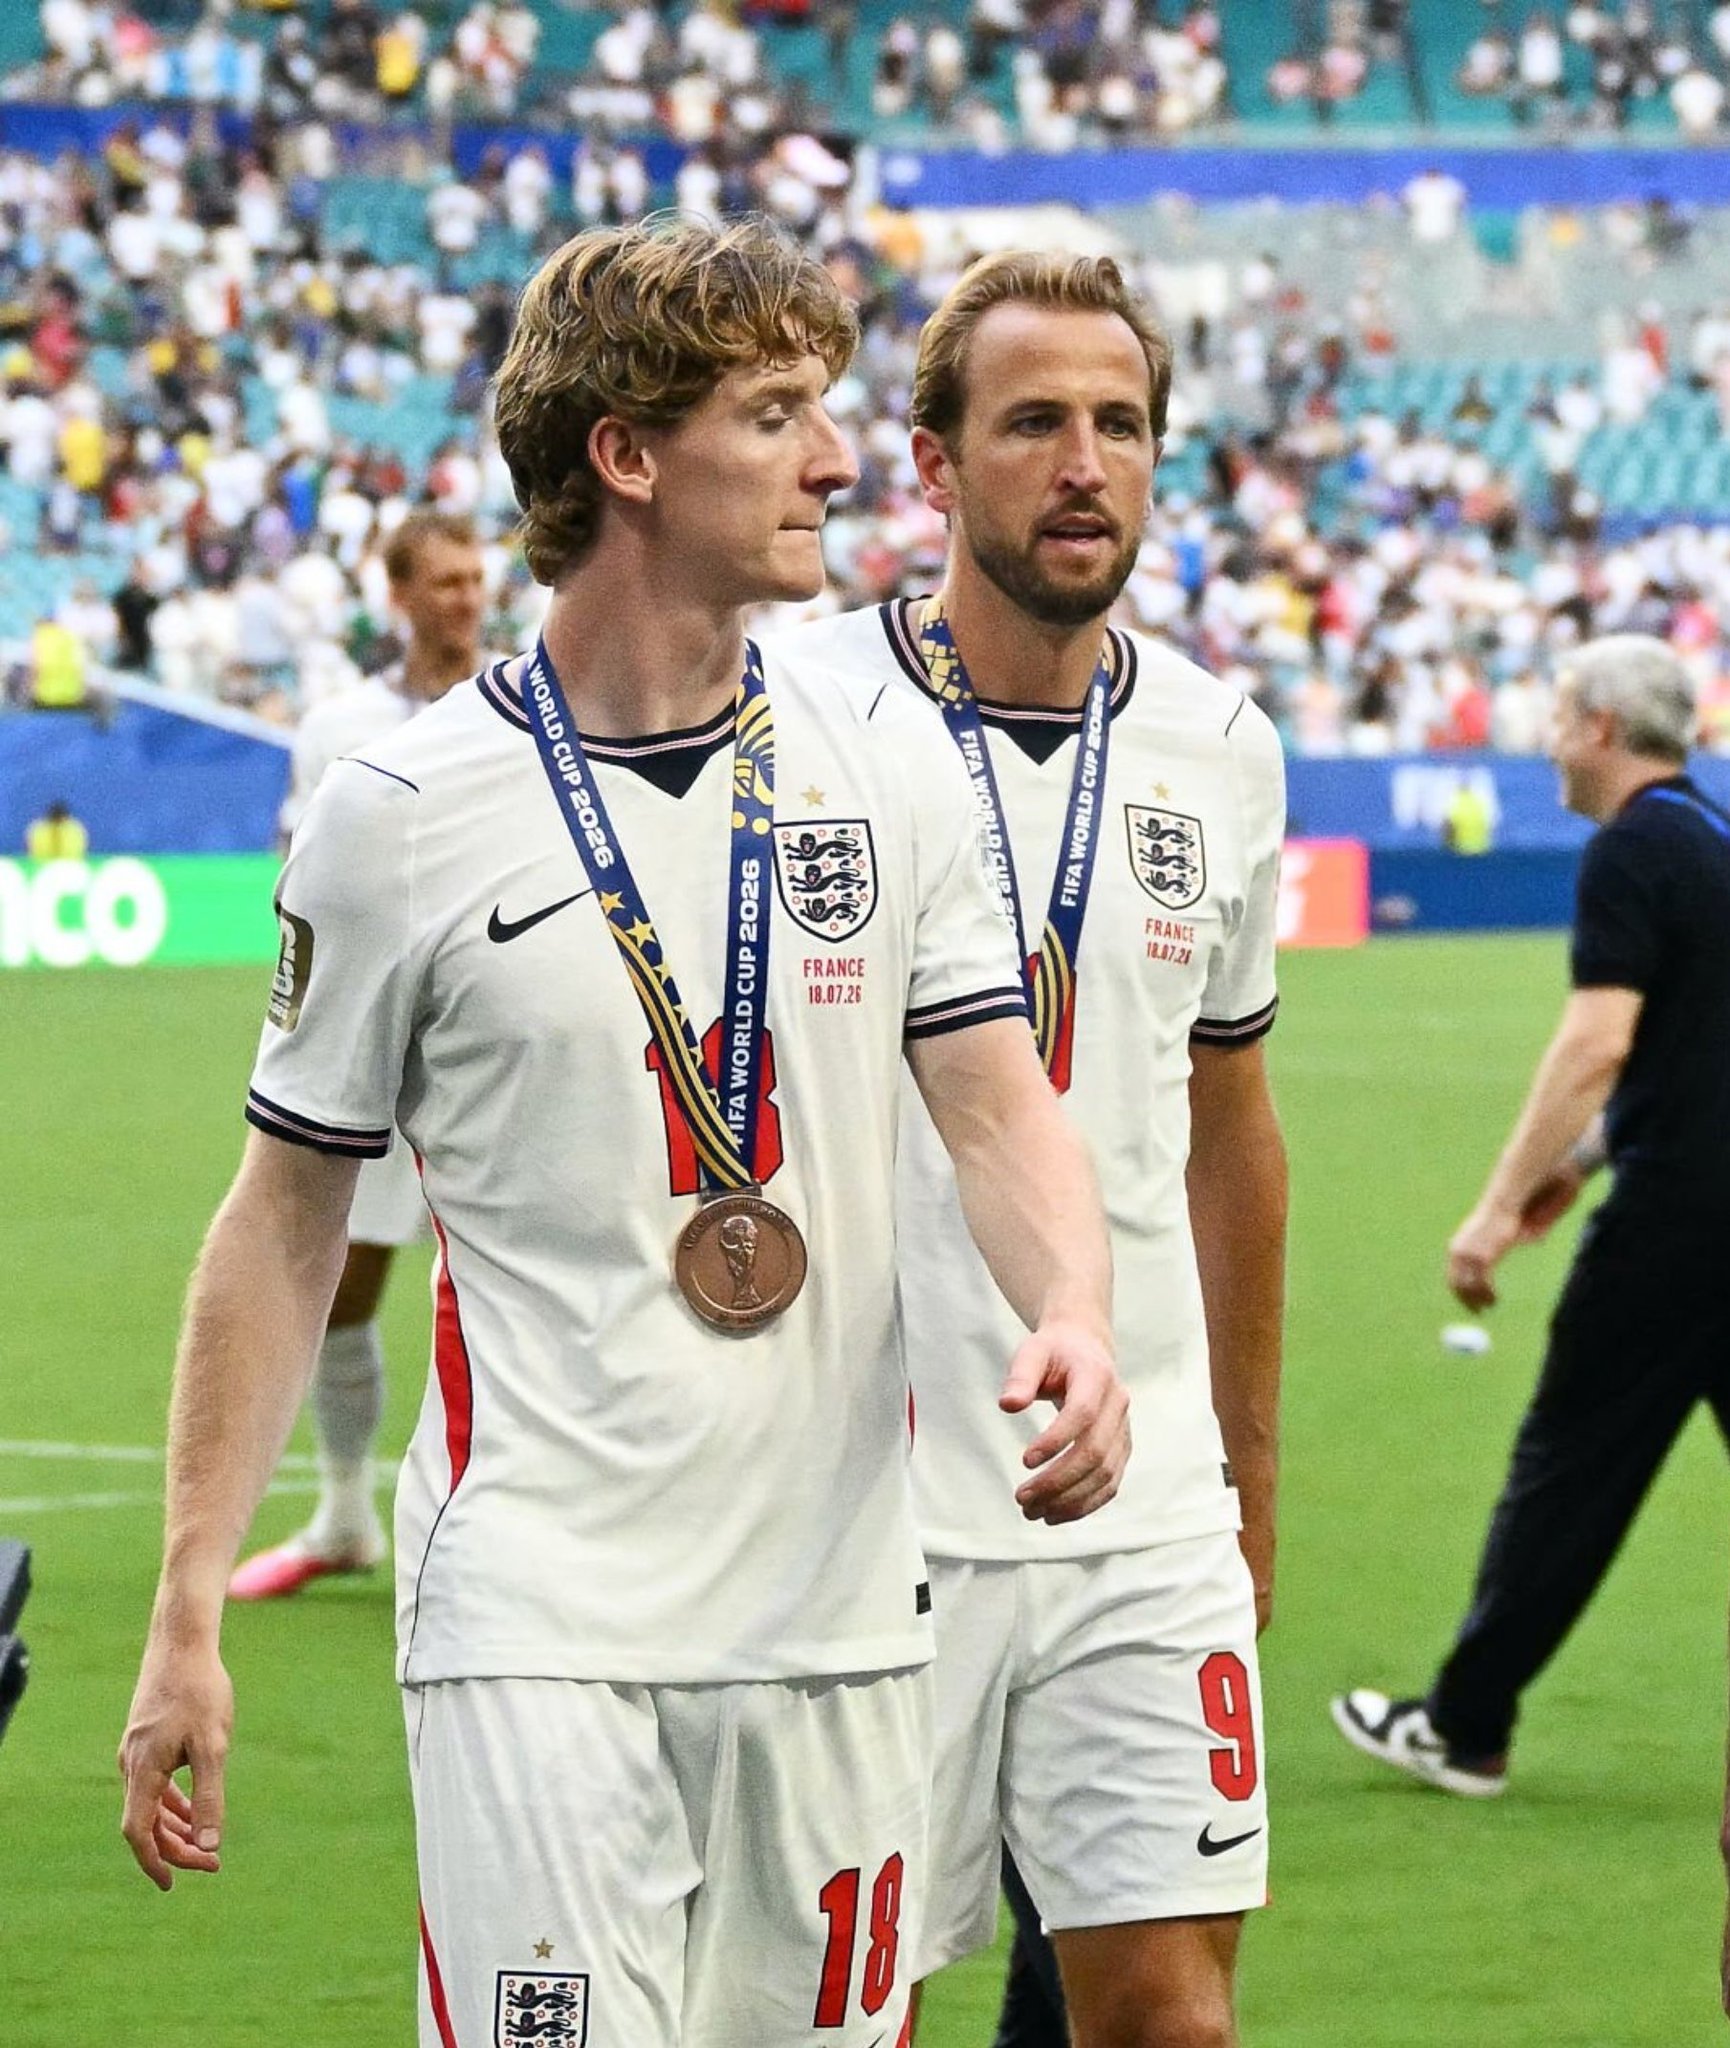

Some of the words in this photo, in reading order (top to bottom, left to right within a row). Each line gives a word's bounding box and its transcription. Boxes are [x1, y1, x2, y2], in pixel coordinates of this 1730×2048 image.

[529, 662, 564, 741] WORLD
[552, 741, 582, 785] CUP
[569, 787, 615, 869] 2026
[958, 729, 984, 775] FIFA
[1081, 750, 1098, 789] CUP
[1069, 790, 1094, 860] WORLD
[739, 858, 760, 942] 2026
[1060, 864, 1084, 907] FIFA
[1145, 918, 1194, 943] FRANCE
[737, 946, 756, 995] CUP
[803, 958, 865, 978] FRANCE
[808, 984, 862, 1004] 18.07.26
[730, 999, 753, 1089] WORLD
[1198, 1651, 1257, 1801] 9
[813, 1851, 904, 2028] 18
